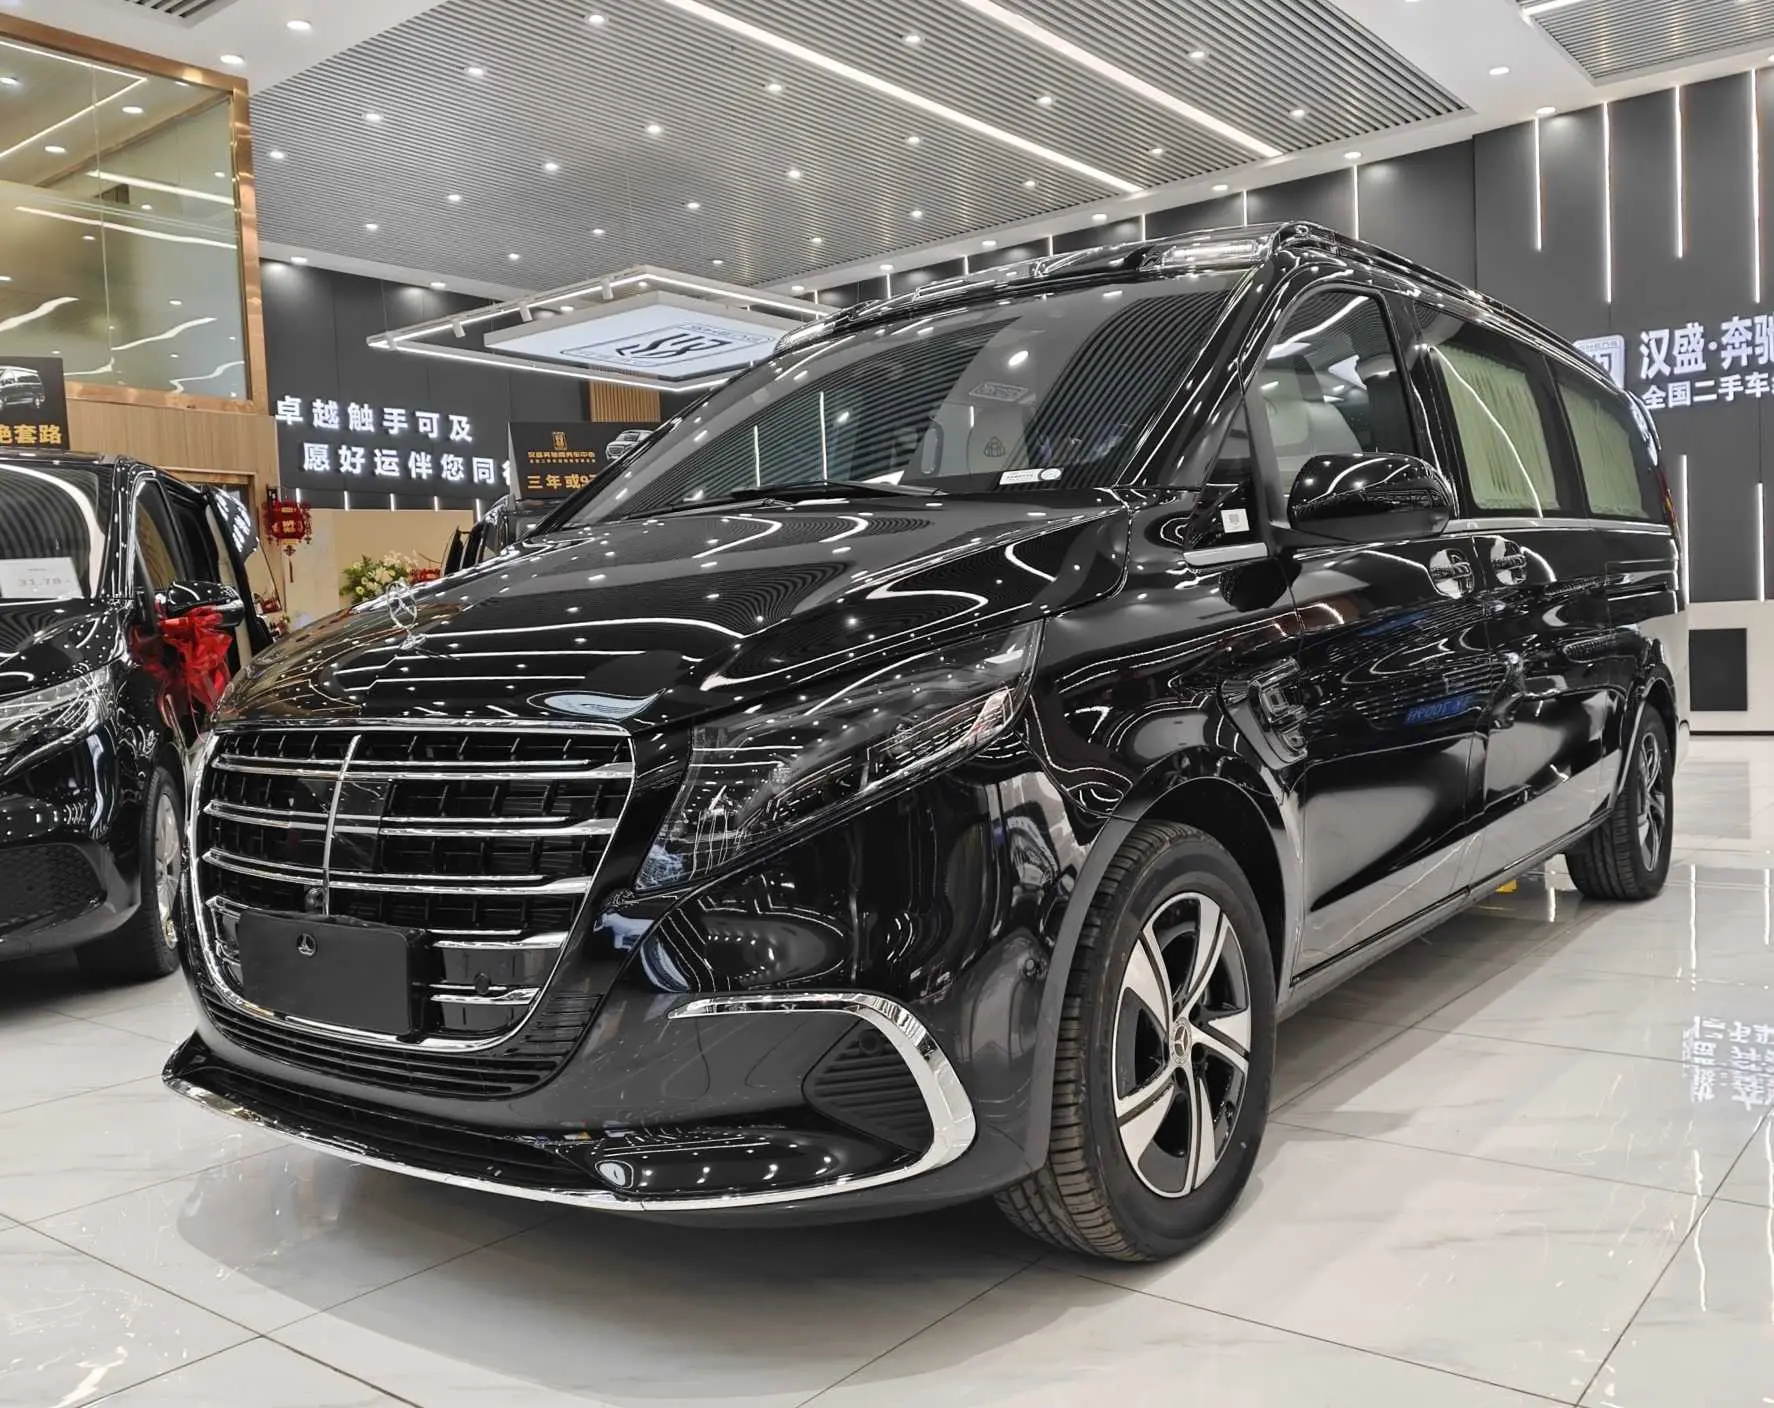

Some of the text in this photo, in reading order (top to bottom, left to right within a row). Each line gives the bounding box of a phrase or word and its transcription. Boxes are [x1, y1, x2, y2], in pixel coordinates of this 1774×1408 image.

[1641, 371, 1774, 410] 全国二手车
[275, 395, 473, 442] 卓越触手可及
[527, 473, 597, 490] 三年或9
